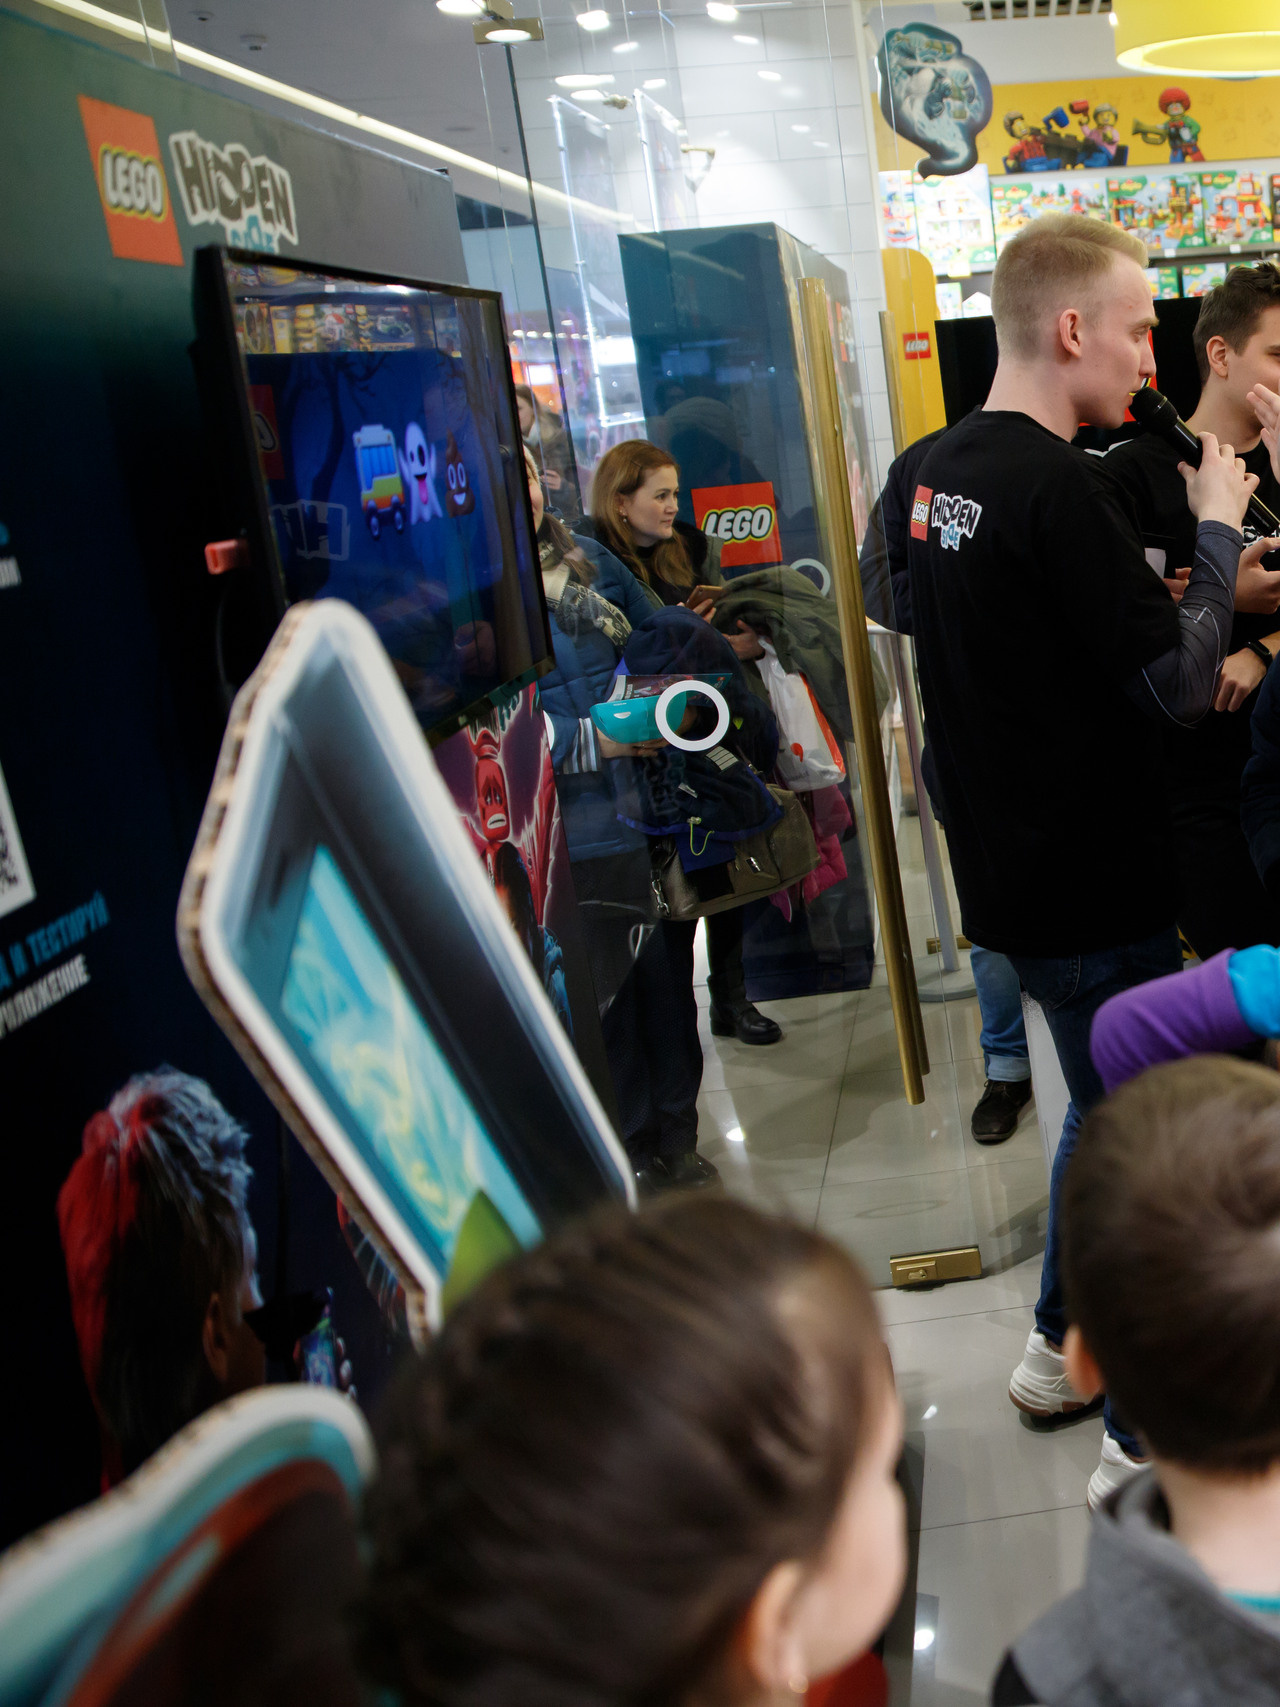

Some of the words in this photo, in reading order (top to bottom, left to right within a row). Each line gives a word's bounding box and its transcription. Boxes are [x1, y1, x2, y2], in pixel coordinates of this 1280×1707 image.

[101, 147, 166, 221] LEGO
[169, 131, 297, 245] HIDDEN
[703, 505, 773, 542] LEGO
[911, 500, 929, 525] LEGO
[931, 493, 982, 539] HIDDEN
